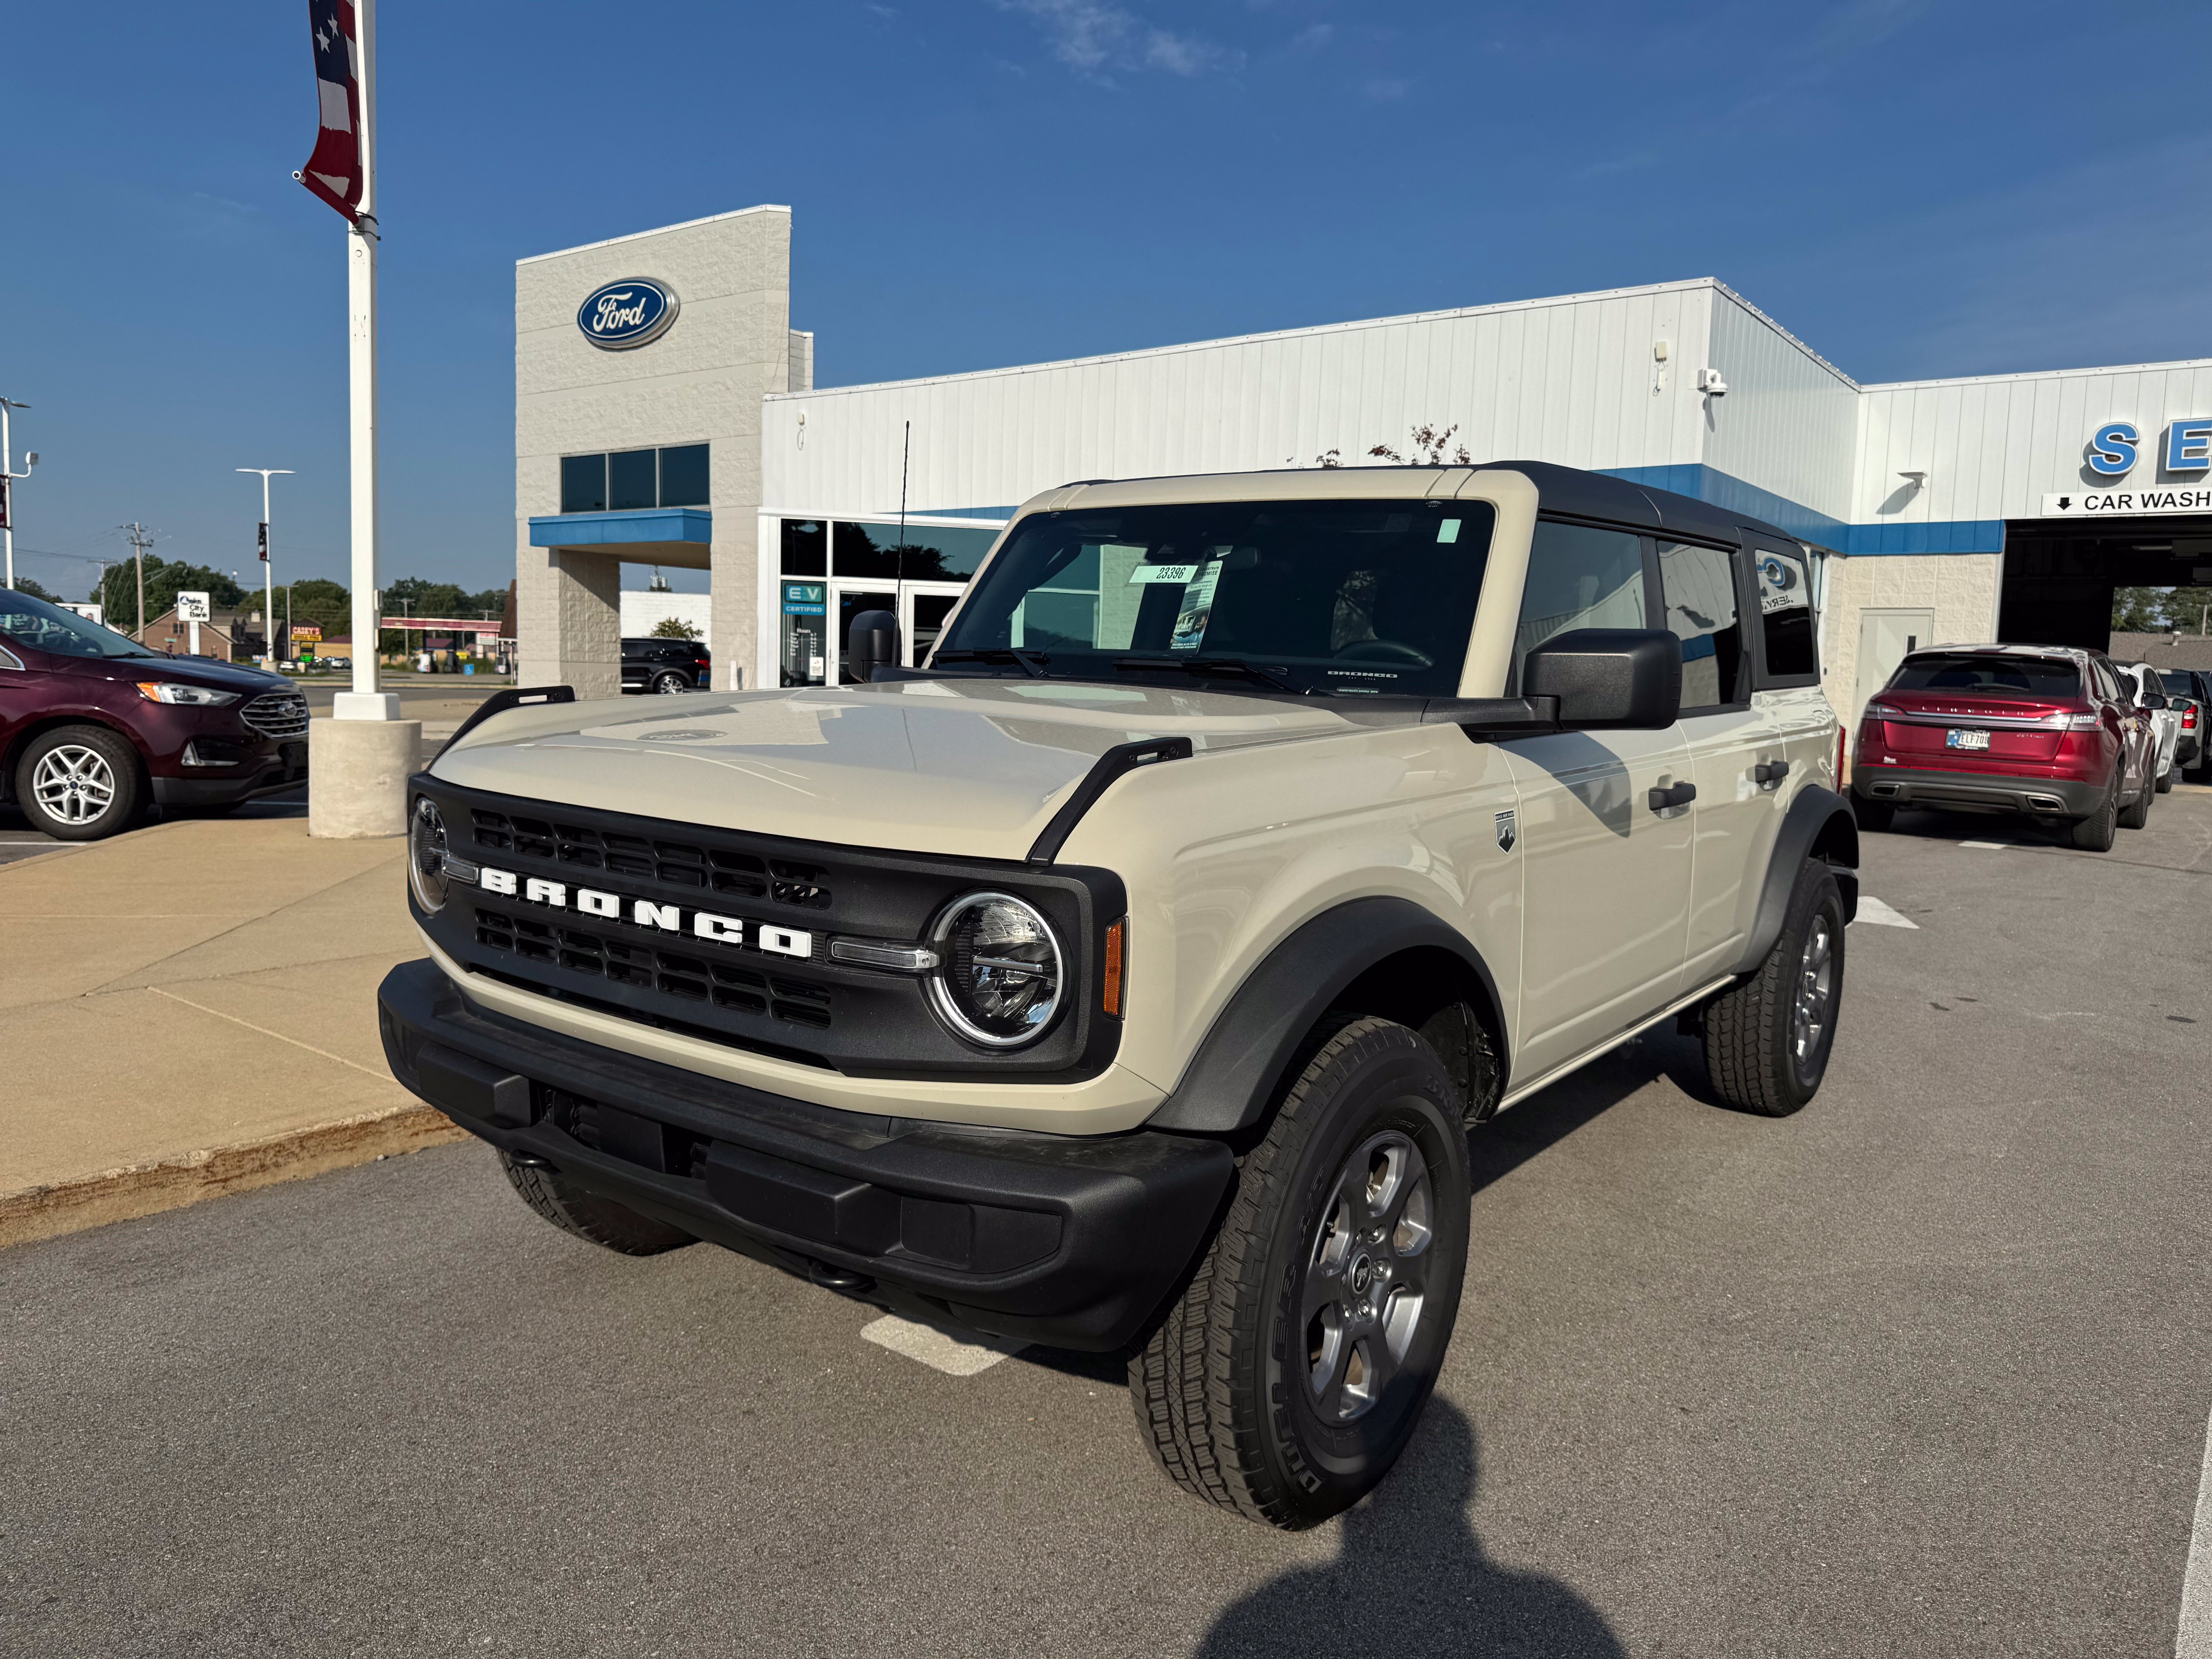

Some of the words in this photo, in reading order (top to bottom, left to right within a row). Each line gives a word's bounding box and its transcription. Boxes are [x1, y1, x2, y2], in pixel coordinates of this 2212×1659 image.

[593, 292, 646, 332] Ford
[2084, 495, 2133, 510] CAR
[2140, 491, 2210, 508] WASH
[1156, 567, 1186, 579] 23396
[481, 867, 812, 958] BRONCO
[1272, 1261, 1325, 1495] DUELER
